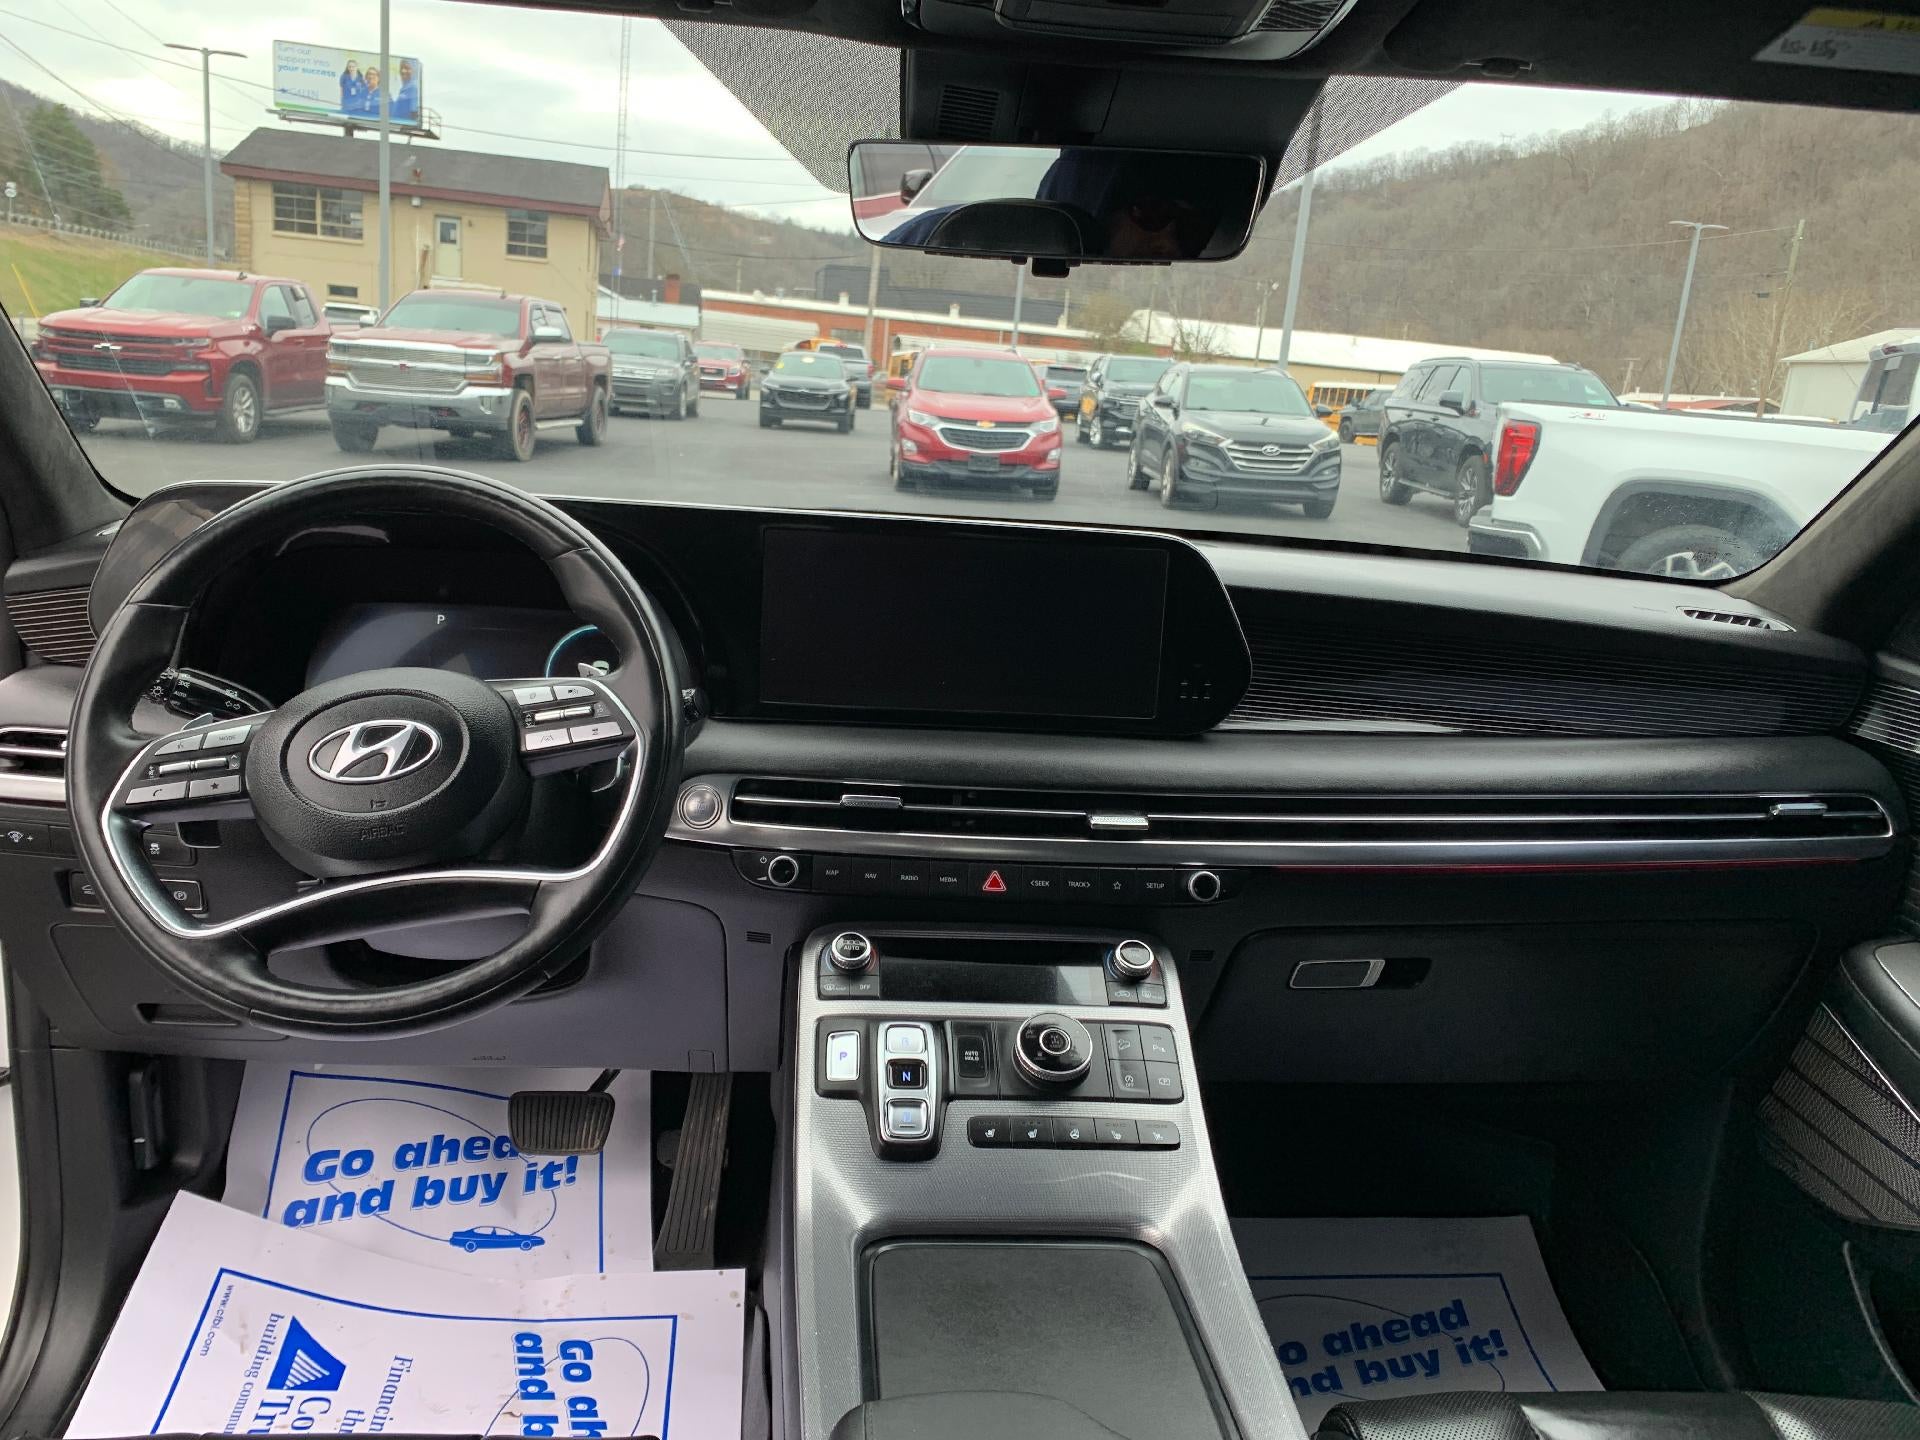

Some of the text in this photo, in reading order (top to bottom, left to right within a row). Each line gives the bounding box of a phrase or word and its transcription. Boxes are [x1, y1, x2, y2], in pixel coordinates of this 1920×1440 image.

[277, 65, 336, 77] your success
[437, 614, 445, 625] P
[825, 868, 840, 877] MAP
[864, 872, 877, 880] NAV
[900, 874, 919, 882] RADIO
[939, 876, 958, 884] MEDIA
[1146, 881, 1165, 889] SETUP
[839, 1051, 848, 1061] P
[902, 1071, 912, 1082] N
[303, 1134, 532, 1183] Go ahea
[281, 1155, 579, 1229] and buy it!
[1279, 1299, 1470, 1365] o ahead
[224, 1312, 285, 1434] building commu
[1288, 1328, 1509, 1397] nd buy it!
[368, 1354, 414, 1432] Financin
[513, 1331, 560, 1437] and b
[558, 1339, 608, 1438] Go ah
[290, 1396, 332, 1432] Co
